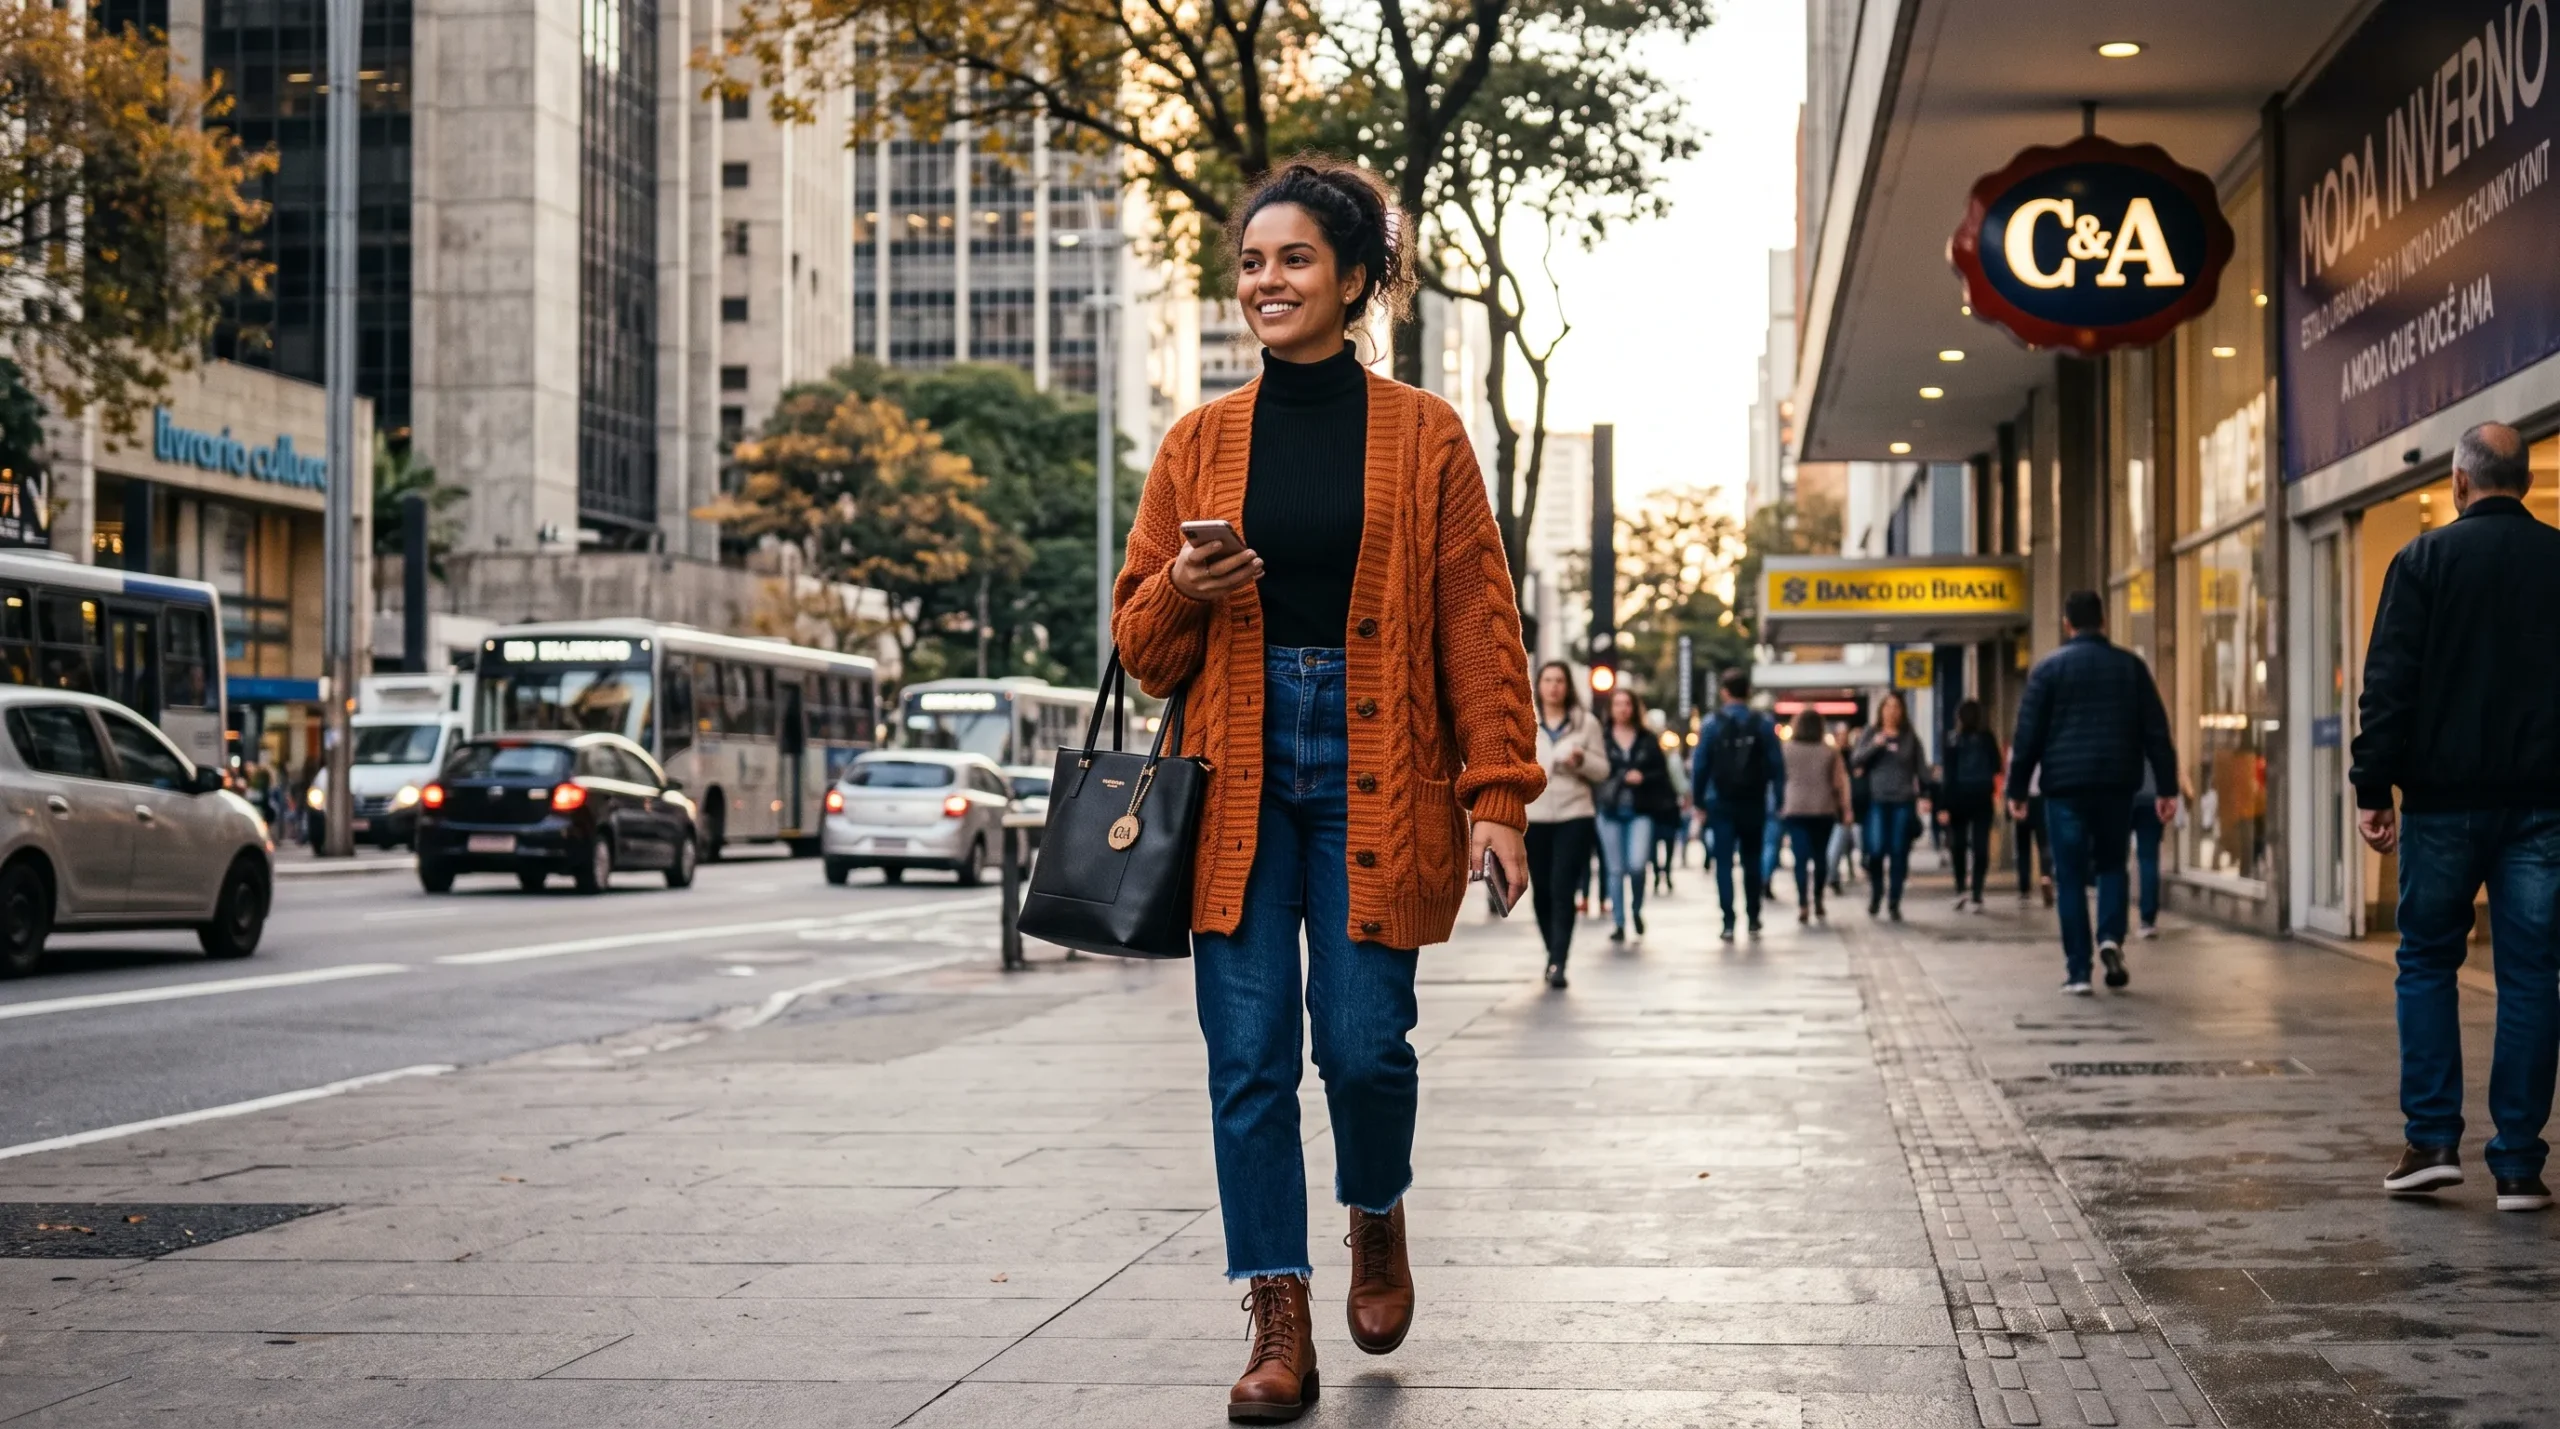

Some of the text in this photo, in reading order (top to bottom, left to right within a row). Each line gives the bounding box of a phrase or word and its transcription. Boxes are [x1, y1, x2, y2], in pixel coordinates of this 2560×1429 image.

[2300, 0, 2549, 288] MODA INVERNO
[2433, 202, 2465, 259] LOOK
[2466, 161, 2517, 235] CHUNKY
[2519, 137, 2550, 197] KNIT
[2004, 198, 2185, 289] C&A
[2341, 271, 2495, 404] A MODA QUE VOCÊ AMA
[1816, 579, 1893, 601] BANCO
[1931, 578, 2006, 600] BRASIL
